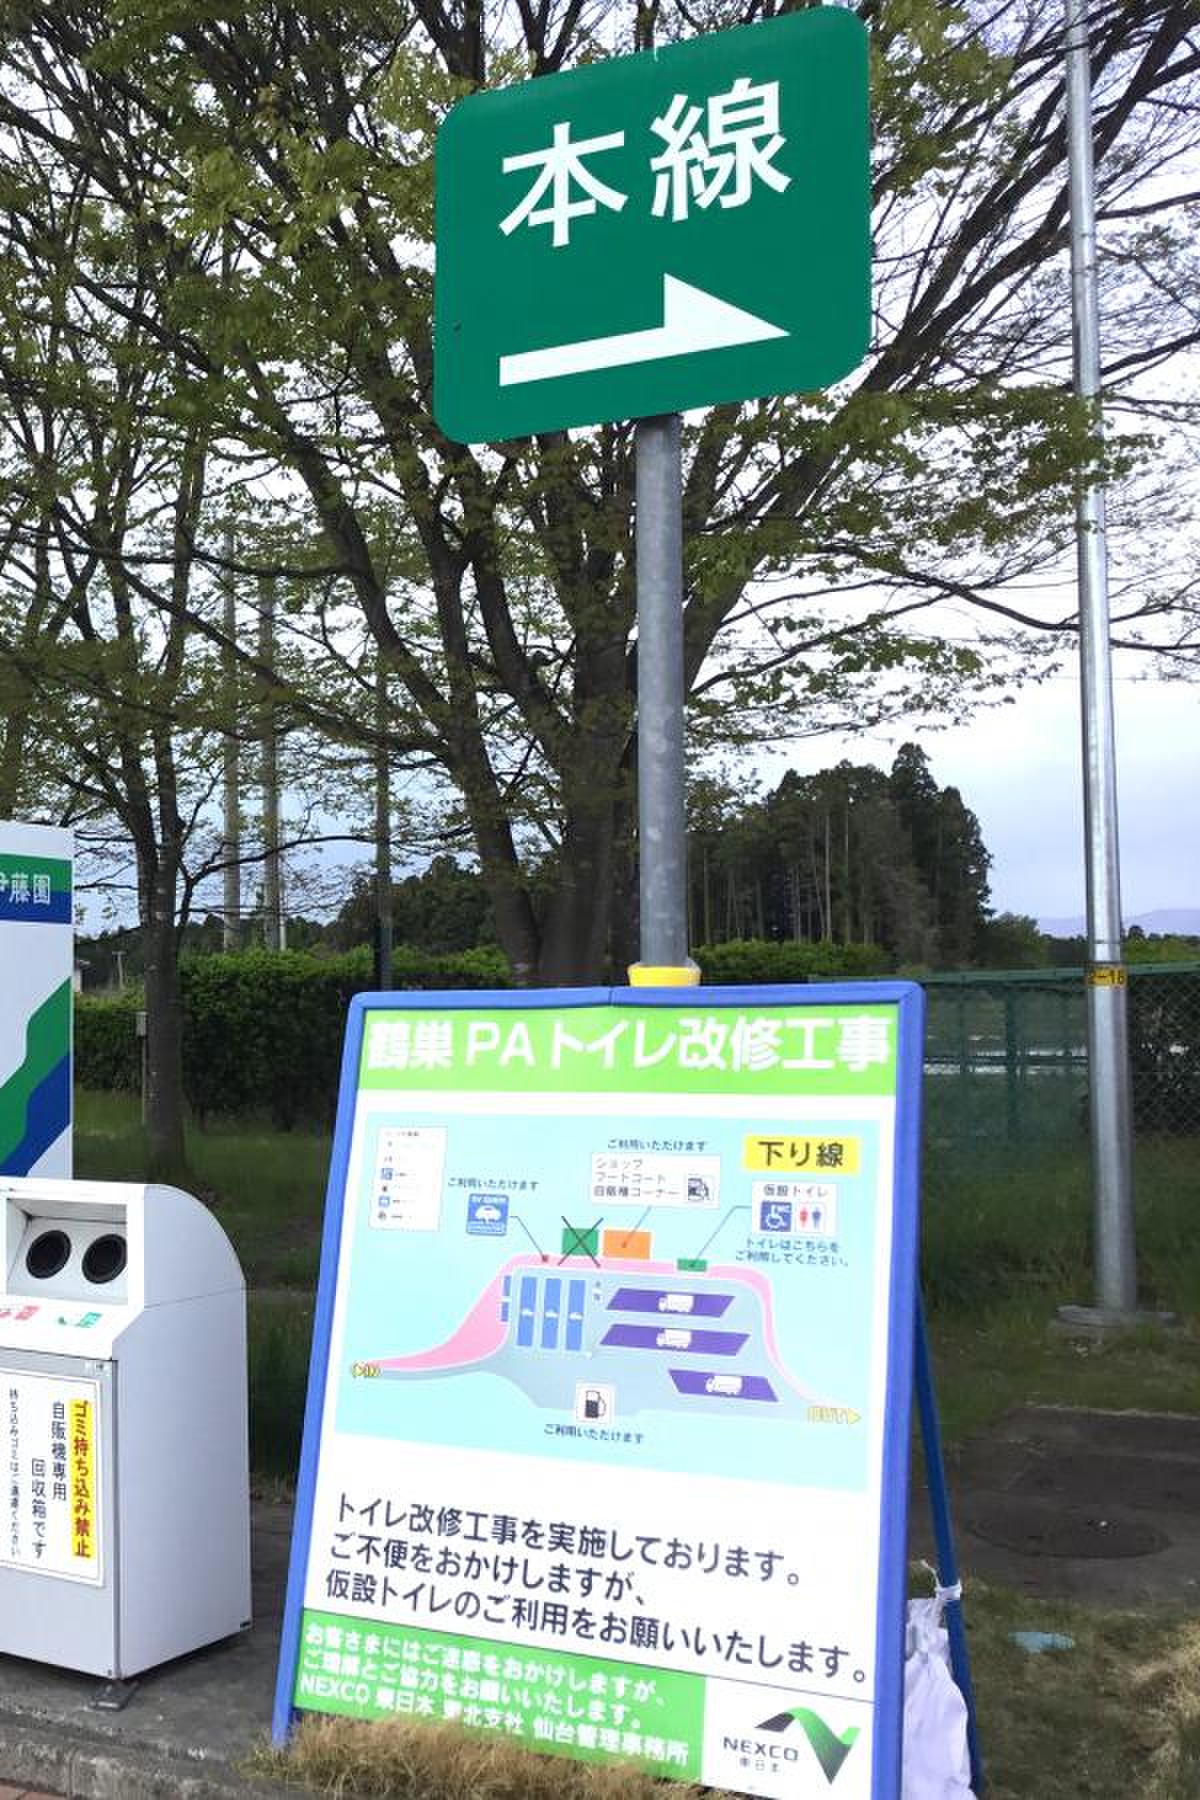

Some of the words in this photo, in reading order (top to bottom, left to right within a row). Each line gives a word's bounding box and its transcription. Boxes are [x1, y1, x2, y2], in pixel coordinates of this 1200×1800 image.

[500, 76, 791, 248] 本線
[466, 1022, 537, 1067] PA
[552, 1015, 893, 1072] トイレ改修工事
[607, 1138, 708, 1153] ご利用いただけます
[757, 1140, 845, 1168] 下り線
[447, 1176, 540, 1192] ご利用いただけます
[763, 1184, 828, 1198] 仮設トイレ
[735, 1250, 849, 1268] ご利用してください。
[746, 1238, 840, 1253] トイレはこちらを
[51, 1401, 67, 1501] 自販機専用
[543, 1423, 644, 1445] ご利用いただけます
[73, 1400, 91, 1559] ゴミ持ち込み禁止
[31, 1457, 47, 1559] 回収箱です
[339, 1492, 800, 1586] トイレ改修工事を実施しております。
[330, 1531, 645, 1606] ご不便をおかけしますが、
[325, 1568, 866, 1684] 仮設トイレのご利用をお願いいたします。
[300, 1673, 371, 1705] NEXCO
[303, 1650, 642, 1730] ご理解とご協力をお願いいたします。
[723, 1735, 799, 1762] NEXCO
